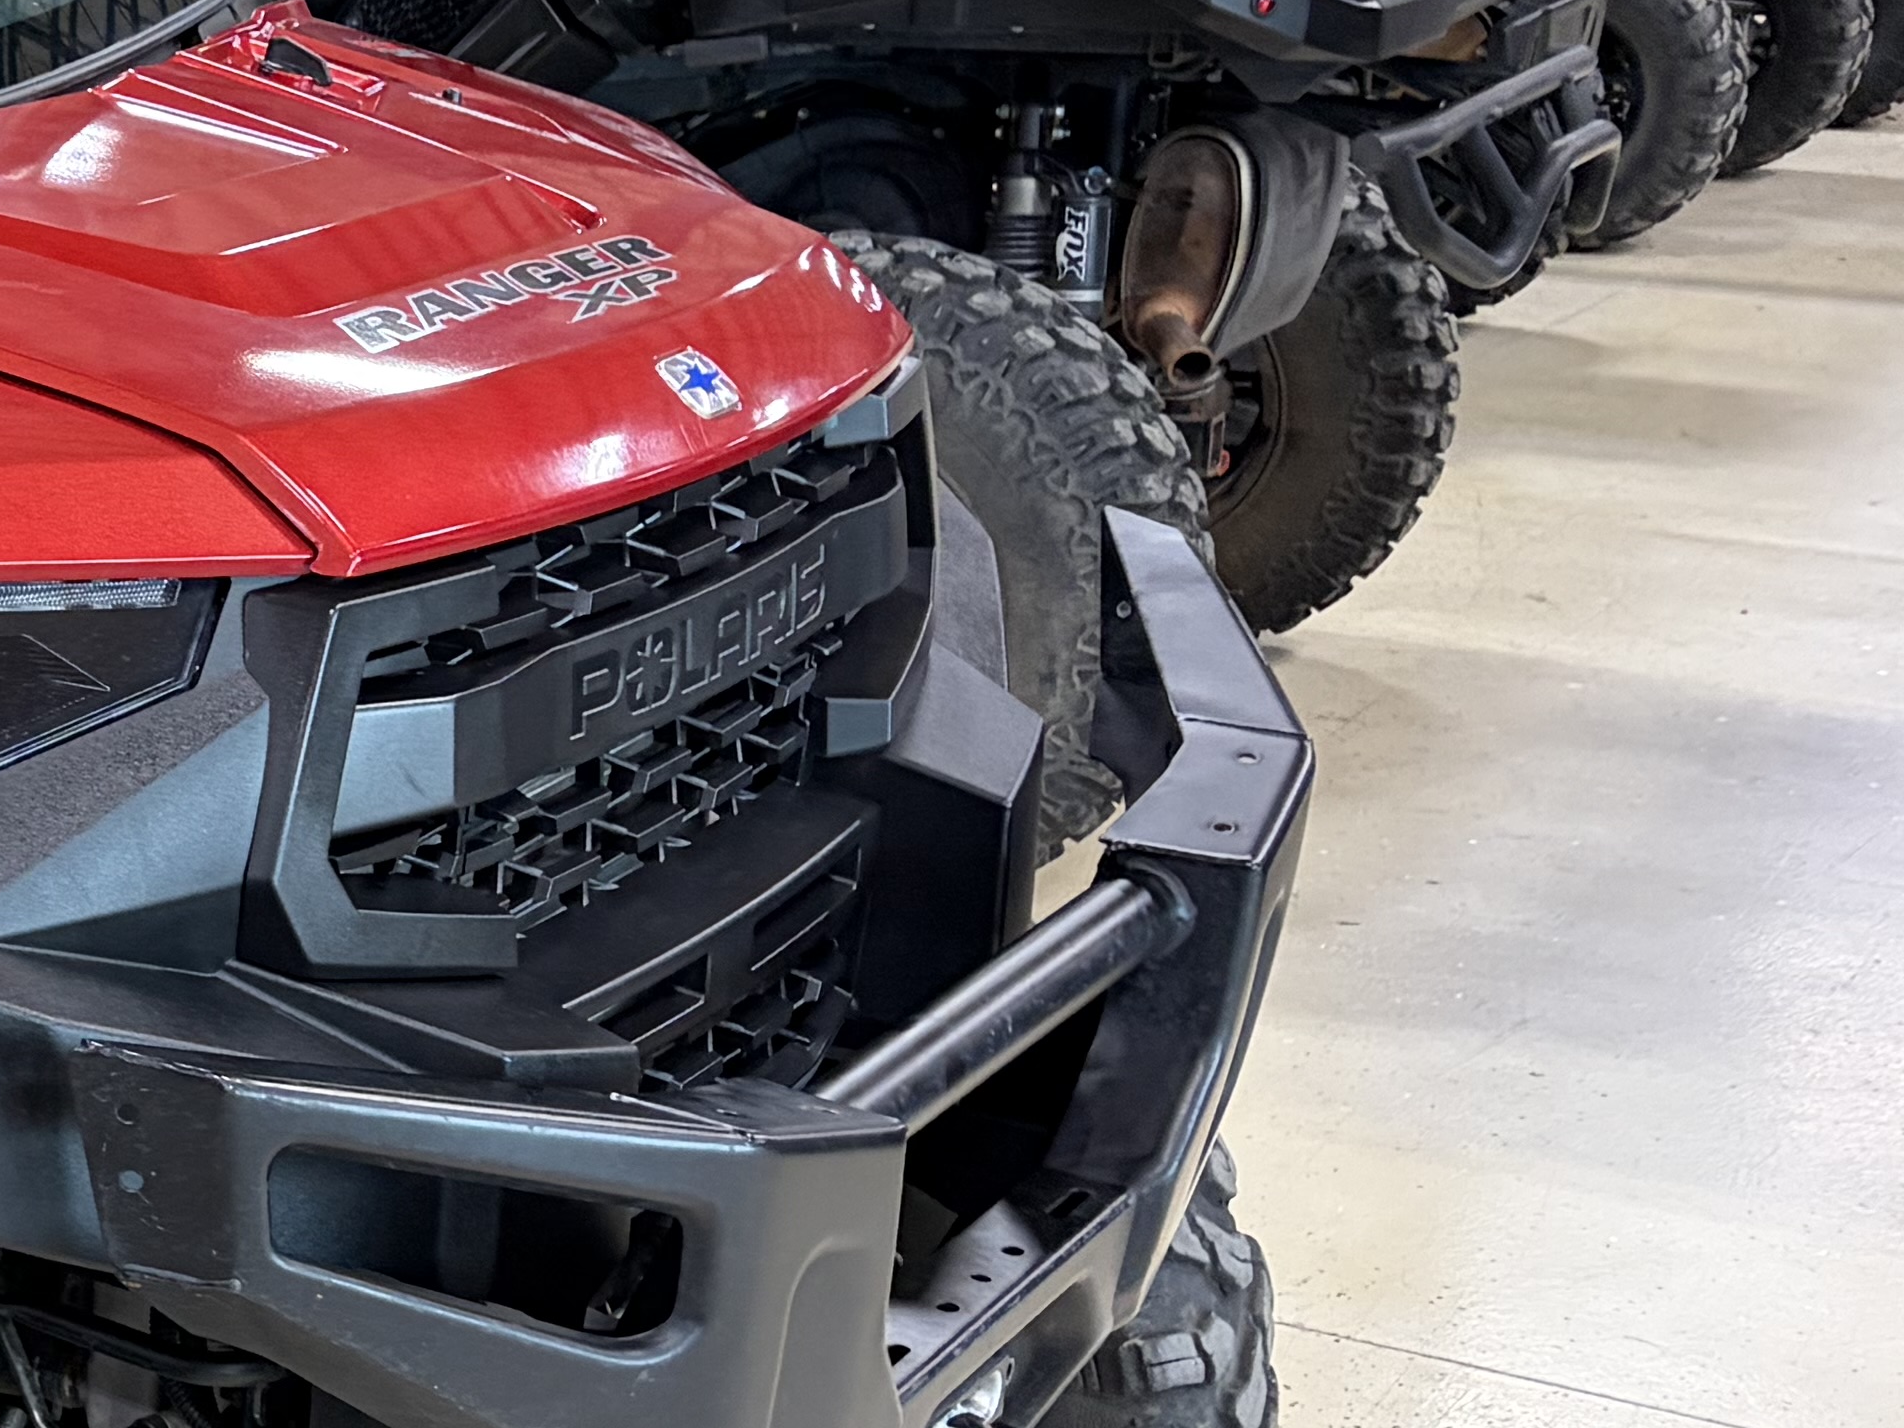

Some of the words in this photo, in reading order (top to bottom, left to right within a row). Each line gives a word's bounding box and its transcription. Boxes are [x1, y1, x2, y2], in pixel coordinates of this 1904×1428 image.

[1056, 206, 1090, 282] FOX
[332, 234, 674, 355] RANGER
[547, 267, 680, 325] XP
[570, 543, 826, 741] POLARIS
